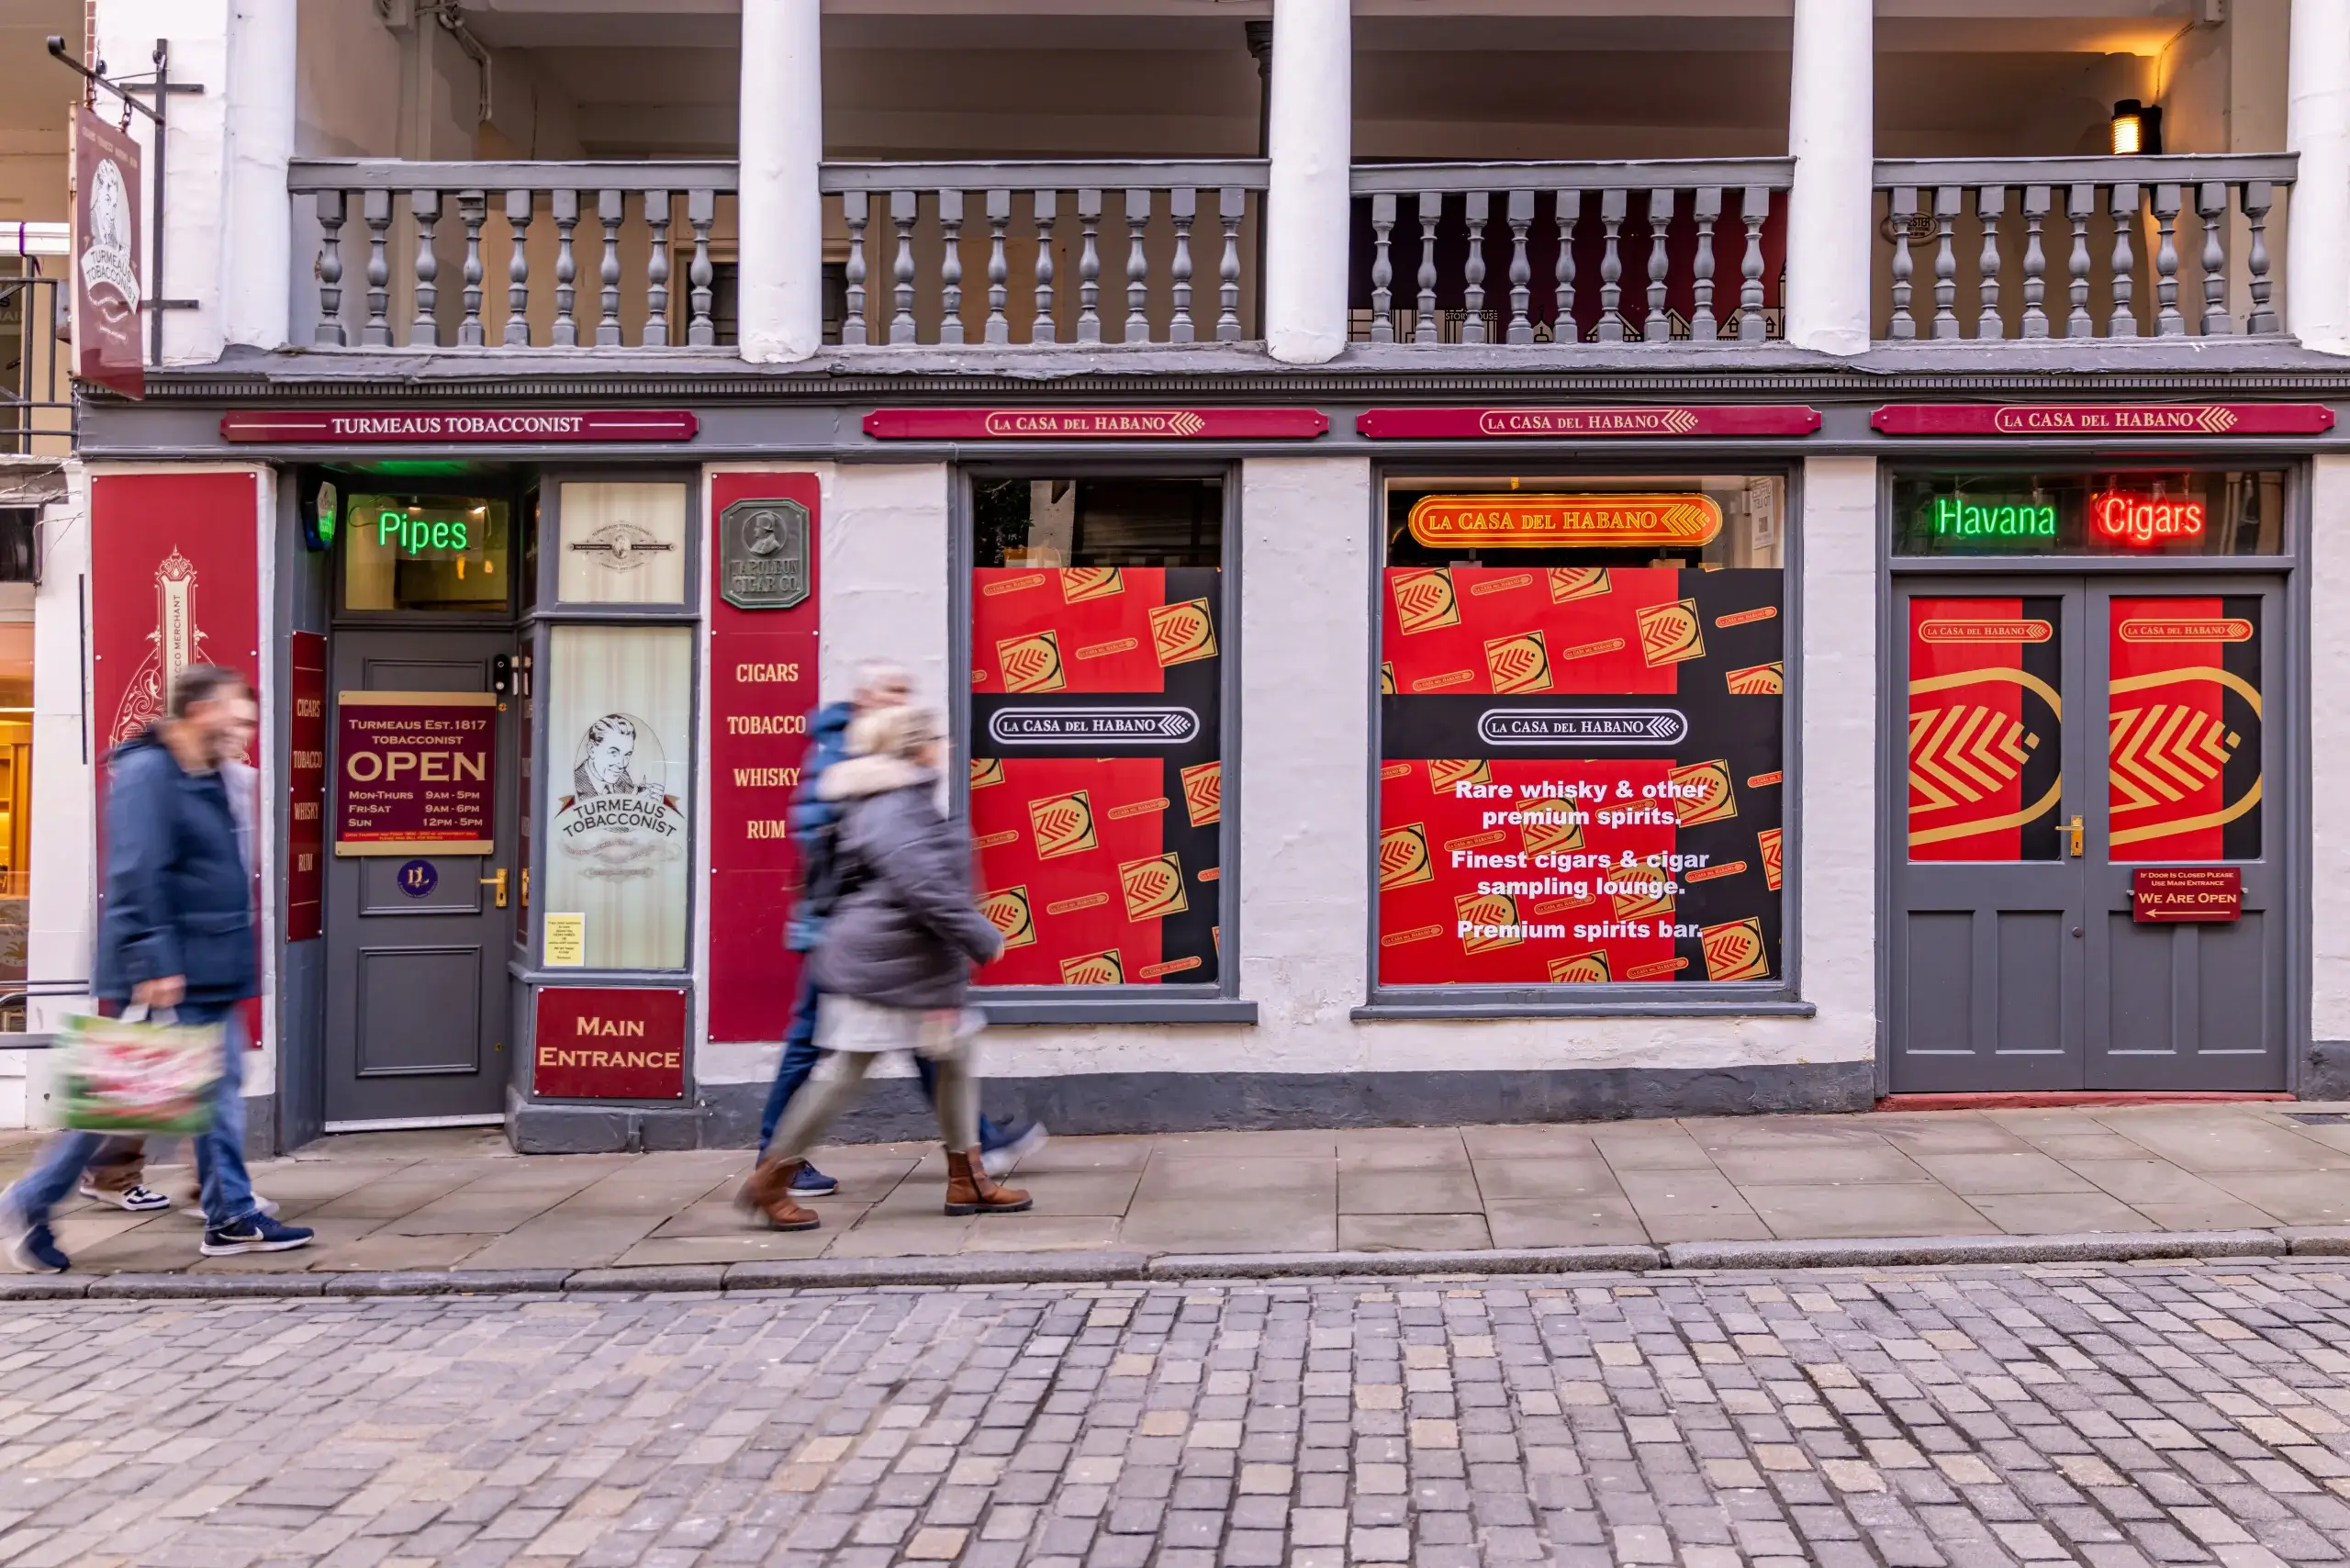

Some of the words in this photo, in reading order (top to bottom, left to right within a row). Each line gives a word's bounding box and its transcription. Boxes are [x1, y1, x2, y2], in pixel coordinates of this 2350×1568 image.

[90, 250, 131, 283] TURMEAUS
[86, 265, 136, 304] TOBACCONIST
[332, 418, 441, 433] TURMEAUS
[446, 416, 582, 433] TOBACCONIST
[995, 420, 1010, 430] LA
[1017, 418, 1057, 430] CASA
[1064, 420, 1089, 430] DEL
[1095, 417, 1165, 430] HABANO
[1488, 419, 1505, 429] LA
[1510, 416, 1552, 429] CASA
[1558, 418, 1583, 429] DEL
[1589, 416, 1659, 428] HABANO
[2004, 416, 2023, 427] LA
[2028, 413, 2074, 427] CASA
[2081, 415, 2109, 427] DEL
[2115, 413, 2193, 427] HABANO
[1429, 515, 1452, 530] LA
[1458, 512, 1513, 530] CASA
[1521, 514, 1556, 529] DEL
[1563, 511, 1657, 529] HABANO
[1939, 498, 2055, 535] Havana
[2104, 498, 2202, 541] Cigars
[379, 513, 467, 554] Pipes
[730, 559, 800, 576] NAPOLEON
[733, 577, 777, 593] CIGAR
[173, 595, 182, 650] MERCHANT
[1940, 627, 1964, 635] CASA
[1984, 626, 2024, 635] HABANO
[2140, 626, 2165, 634] CASA
[2185, 626, 2225, 634] HABANO
[736, 663, 799, 682] CIGARS
[297, 698, 320, 717] CIGARS
[727, 716, 806, 734] TOBACCO
[1004, 722, 1019, 732] LA
[1023, 720, 1060, 732] CASA
[1065, 721, 1088, 731] DEL
[1093, 719, 1155, 731] HABANO
[1492, 722, 1507, 733] LA
[1511, 720, 1548, 733] CASA
[1554, 722, 1576, 733] DEL
[1580, 720, 1644, 733] HABANO
[372, 736, 463, 745] TOBACCONIST
[293, 750, 322, 768] TOBACCO
[347, 751, 486, 782] OPEN
[733, 768, 800, 786] WHISKY
[1456, 781, 1513, 798] Rare
[1520, 780, 1607, 802] whisky
[1616, 781, 1634, 798] &
[1642, 780, 1707, 798] other
[295, 802, 319, 820] WHISKY
[573, 799, 667, 819] TURMEAUS
[1483, 807, 1589, 829] premium
[1597, 807, 1682, 829] spirits.
[563, 813, 677, 838] TOBACCONIST
[746, 820, 786, 839] RUM
[299, 854, 313, 871] RUM
[1452, 851, 1527, 868] Finest
[1535, 851, 1611, 873] cigars
[1620, 851, 1638, 868] &
[1646, 851, 1709, 873] cigar
[1477, 878, 1588, 899] sampling
[1596, 878, 1684, 900] lounge.
[1457, 921, 1565, 938] Premium
[1573, 921, 1651, 943] spirits
[1659, 921, 1703, 938] bar.
